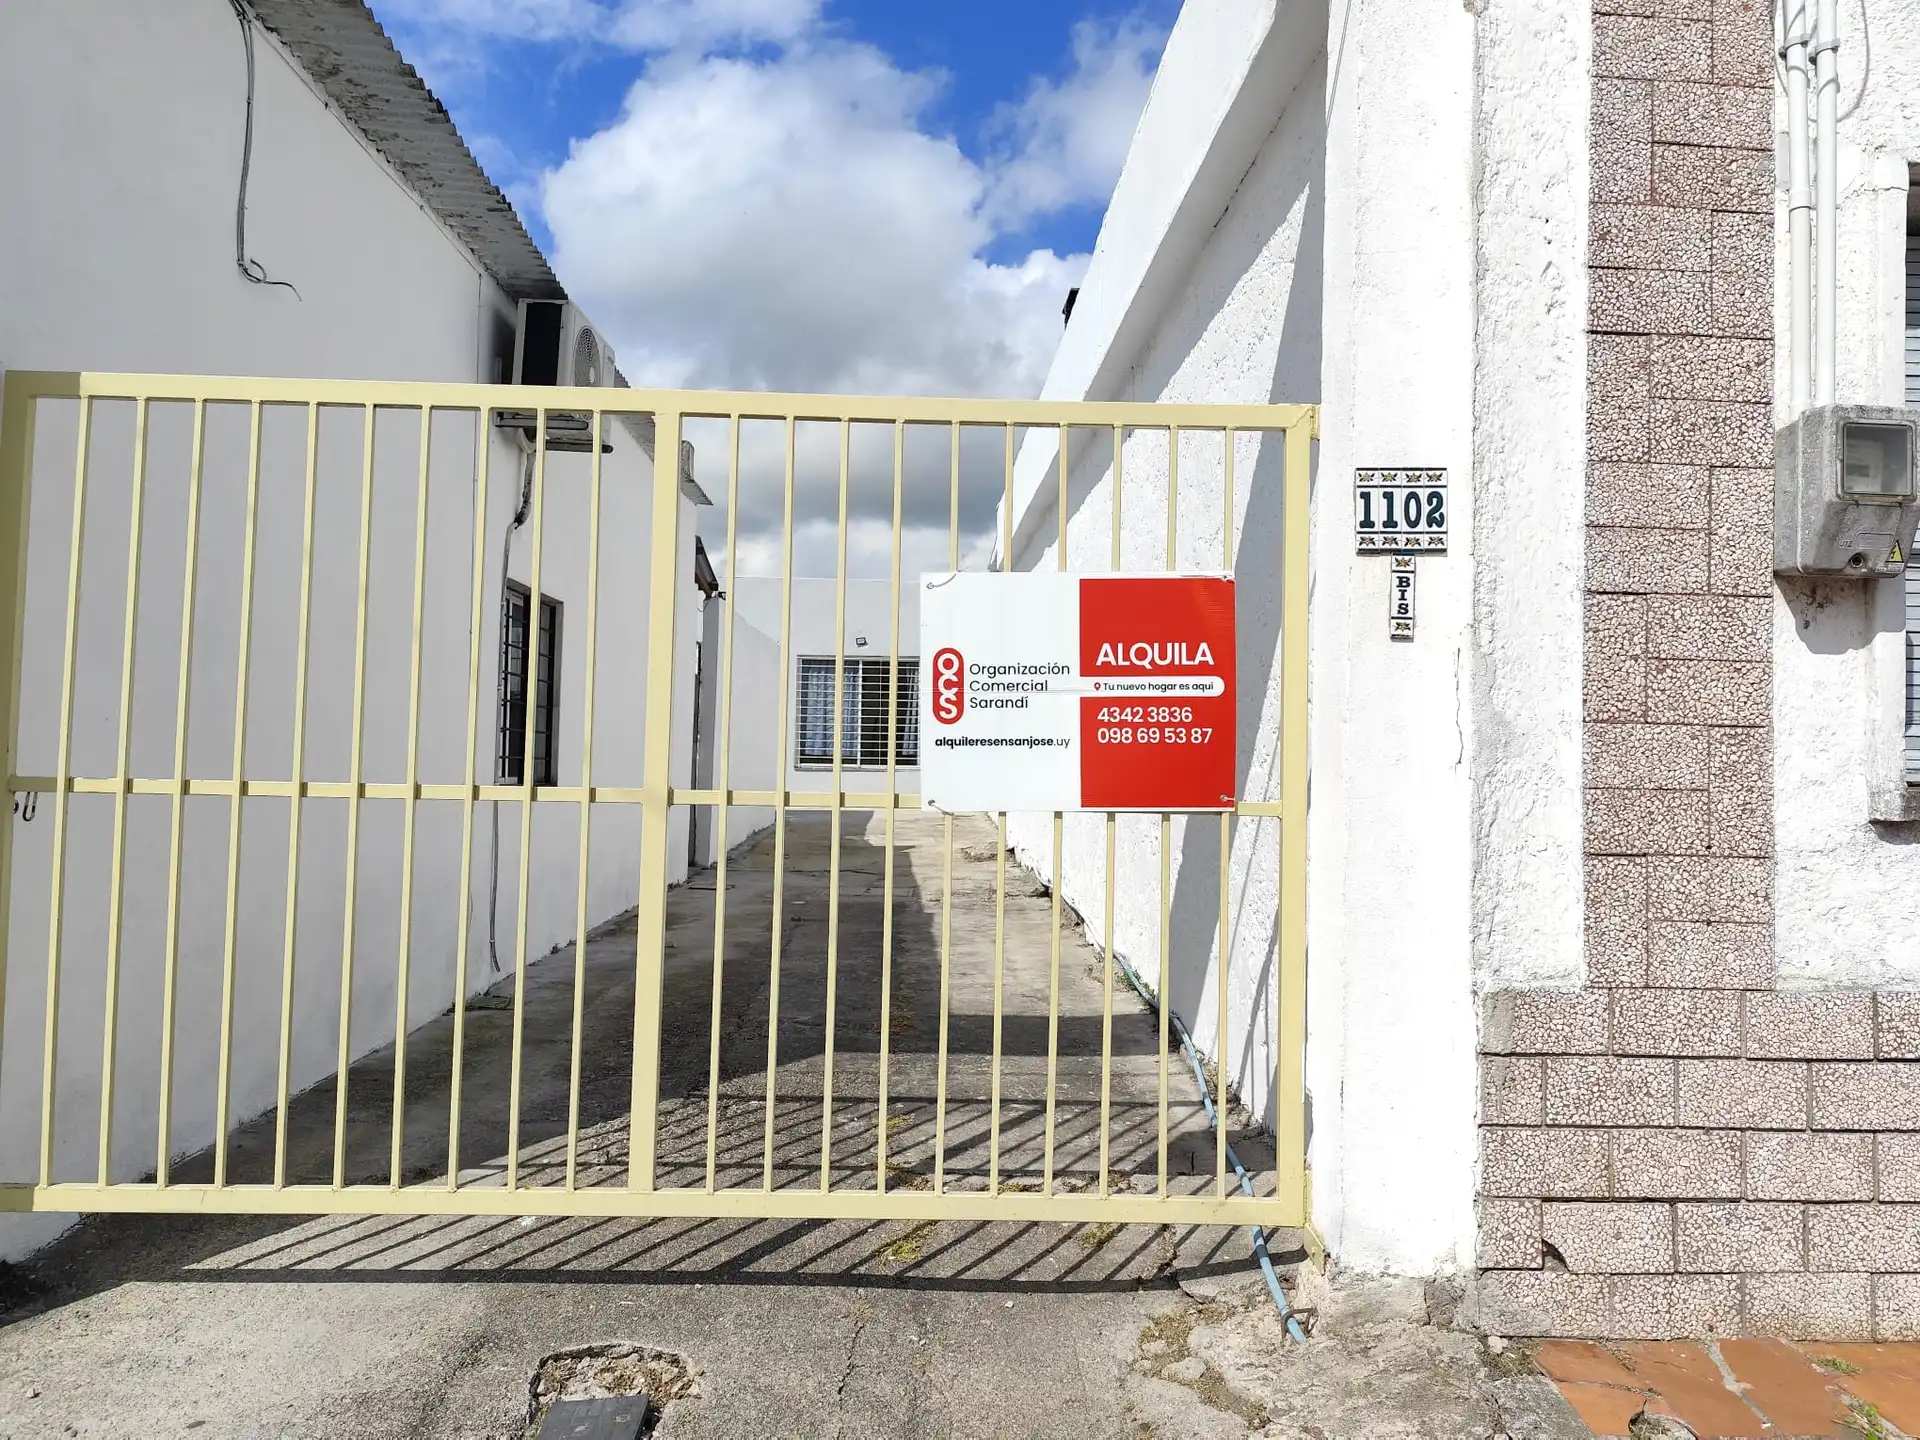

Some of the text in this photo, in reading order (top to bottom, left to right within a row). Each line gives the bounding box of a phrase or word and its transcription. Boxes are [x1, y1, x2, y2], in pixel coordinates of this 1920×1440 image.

[1359, 491, 1445, 529] 1102
[1396, 576, 1411, 615] BIS
[1095, 642, 1215, 669] ALQUILA
[969, 662, 1070, 679] Organización
[937, 653, 959, 719] OCS
[969, 679, 1048, 692] Comercial
[1103, 682, 1115, 691] Tu
[1116, 683, 1147, 691] nuevo
[1148, 682, 1177, 693] hogar
[1178, 683, 1191, 691] es
[969, 695, 1028, 709] Sarandí
[1097, 706, 1193, 723] 4342 3836
[935, 736, 1070, 750] alquileresensanjose.uy
[1097, 727, 1213, 744] 098 69 53 87
